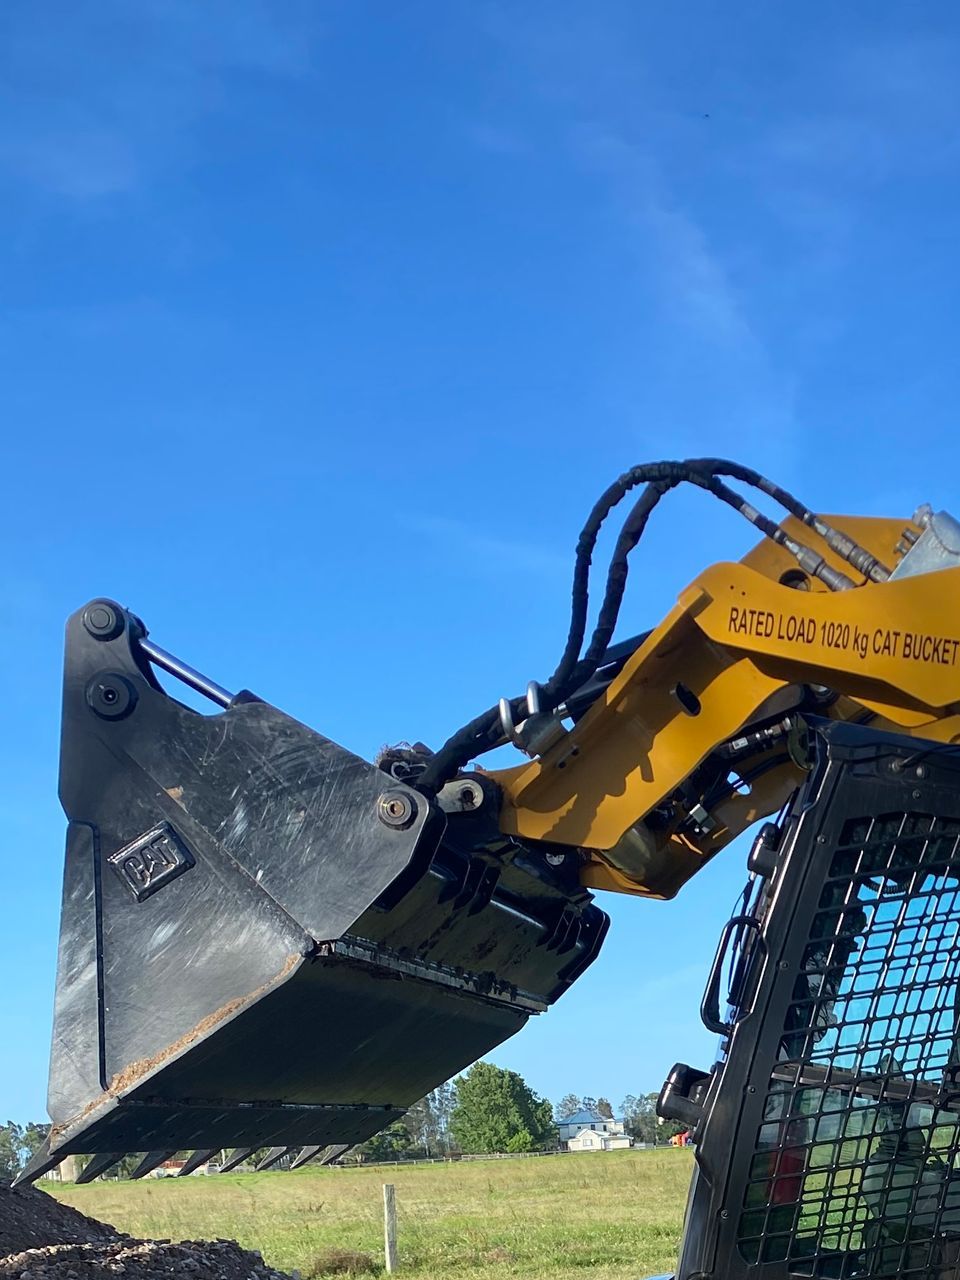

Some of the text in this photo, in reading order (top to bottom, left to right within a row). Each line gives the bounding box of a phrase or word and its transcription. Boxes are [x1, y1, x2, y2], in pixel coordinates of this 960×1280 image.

[728, 606, 775, 638] RATED
[778, 614, 817, 644] LOAD
[821, 621, 850, 650] 1020
[853, 625, 868, 659] kg
[872, 629, 900, 657] CAT
[902, 632, 959, 666] BUCKET
[118, 830, 184, 897] CAT
